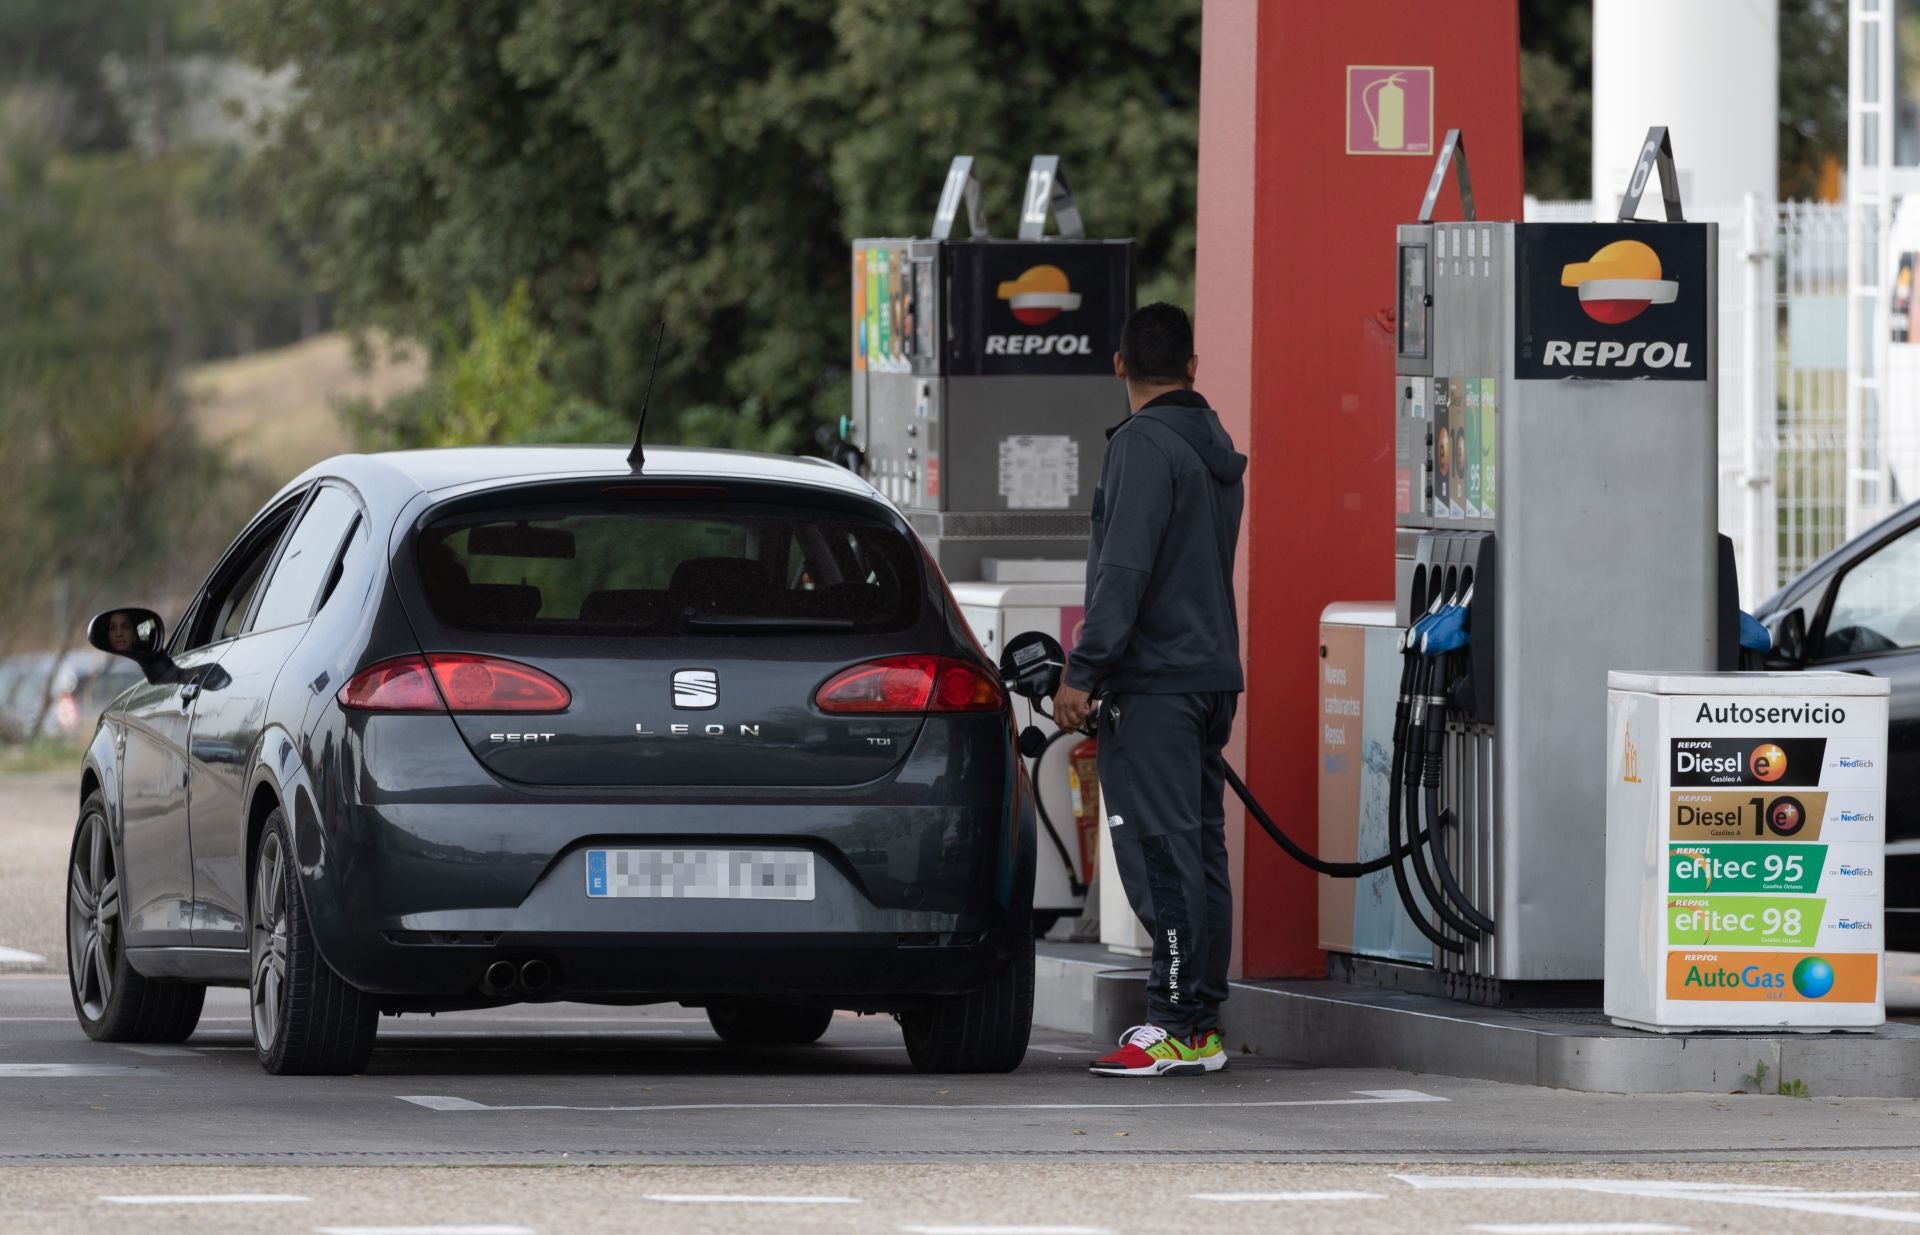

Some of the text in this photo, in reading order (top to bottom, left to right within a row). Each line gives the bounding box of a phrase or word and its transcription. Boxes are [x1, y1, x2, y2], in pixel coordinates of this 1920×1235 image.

[1630, 141, 1656, 198] 6
[1024, 170, 1051, 223] 12
[985, 334, 1093, 356] REPSOL
[1543, 340, 1692, 369] REPSOL
[1470, 463, 1481, 492] 95
[1696, 702, 1846, 725] Autoservicio
[490, 733, 555, 743] SEAT
[636, 723, 759, 736] LEON
[867, 737, 891, 746] TDI
[1677, 741, 1713, 749] REPSOL
[1677, 751, 1742, 773] Diesel
[1839, 759, 1874, 768] NeoTech
[1710, 775, 1736, 783] Gasóleo
[1677, 805, 1742, 826] Diesel
[1749, 796, 1806, 837] 10
[1840, 813, 1874, 822] NeoTech
[1710, 829, 1742, 837] Gasóleo A
[1675, 854, 1804, 882] efitec 95
[1840, 867, 1873, 876] NeoTech
[594, 878, 602, 888] E
[1675, 908, 1802, 936] efitec 98
[1838, 920, 1873, 930] NeoTech
[1167, 928, 1179, 955] FACE
[1169, 957, 1180, 989] NORTH
[1684, 965, 1785, 989] AutoGas
